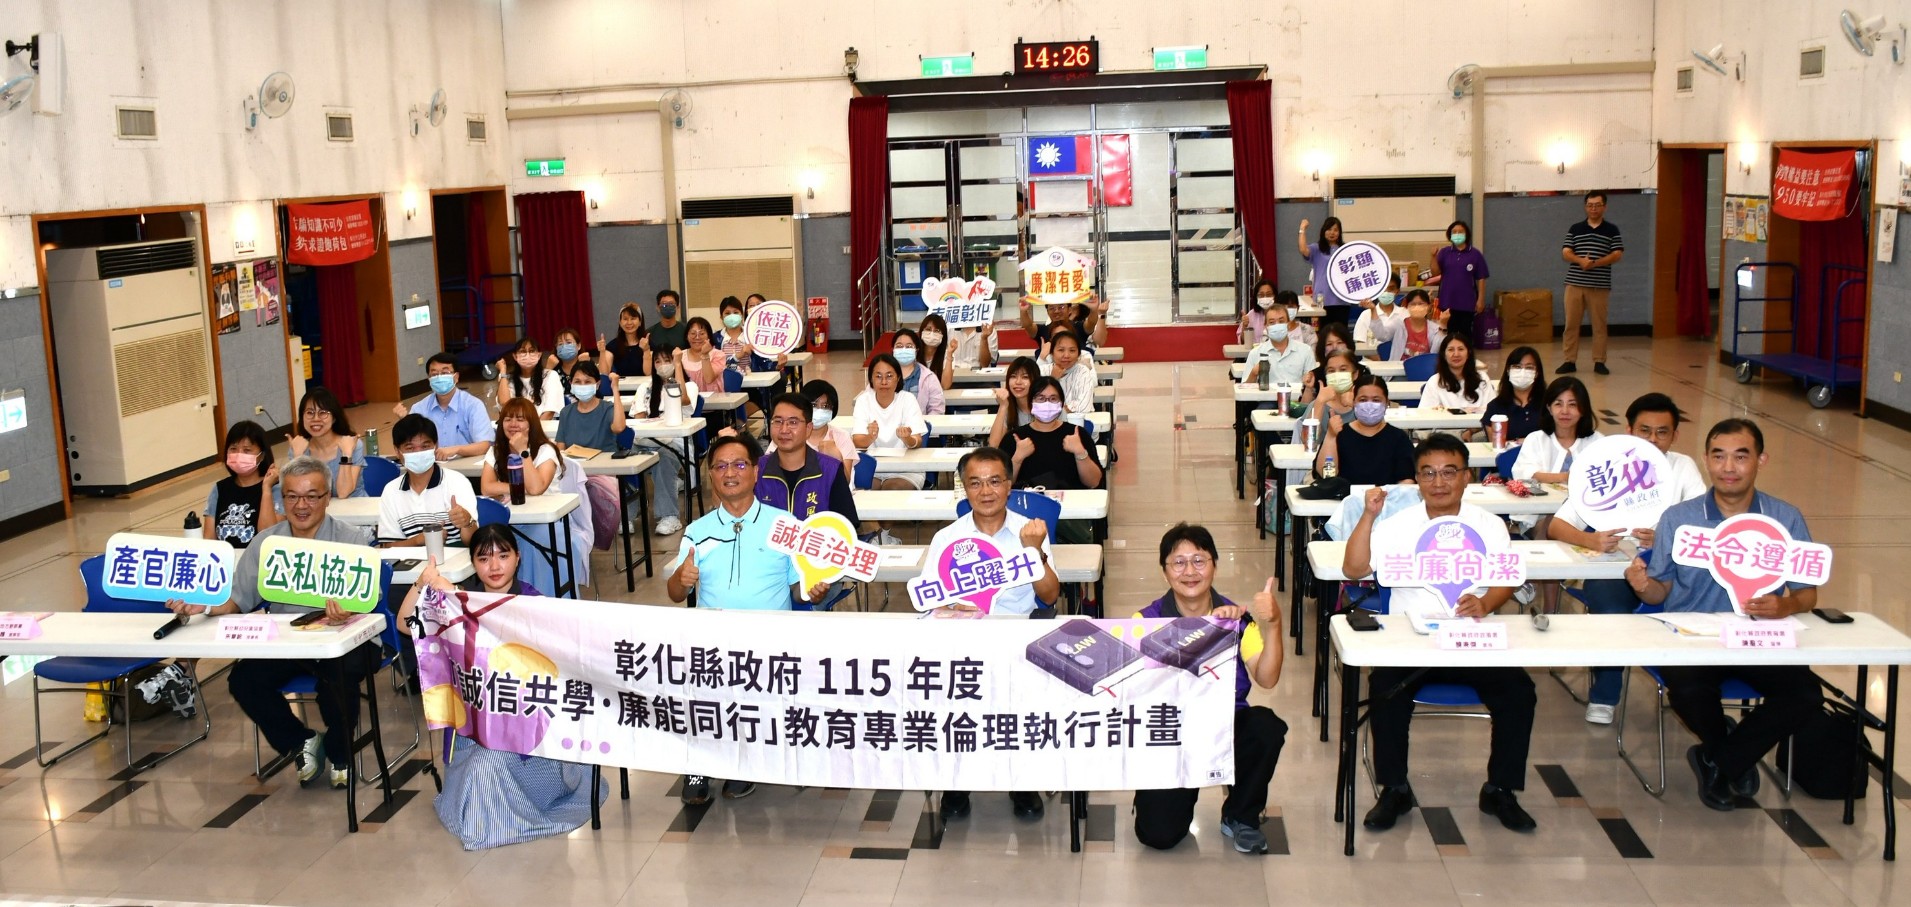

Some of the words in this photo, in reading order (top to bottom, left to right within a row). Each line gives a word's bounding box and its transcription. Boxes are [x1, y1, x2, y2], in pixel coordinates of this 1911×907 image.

[1023, 46, 1090, 68] 14:26
[1338, 250, 1374, 274] 彰顯
[1031, 270, 1084, 294] 廉潔有愛
[1345, 270, 1381, 294] 廉能
[758, 310, 791, 330] 依法
[755, 329, 788, 348] 行政
[1585, 459, 1656, 497] 彰化
[771, 519, 878, 576] 誠信治理
[1678, 530, 1826, 578] 法令遵循
[109, 545, 227, 593] 產官廉心
[266, 549, 373, 599] 公私協力
[914, 553, 1036, 606] 向上躍升
[1384, 552, 1520, 581] 崇廉尚潔
[1066, 635, 1097, 656] LAW
[1177, 629, 1206, 647] LAW
[613, 639, 802, 697] 彰化縣政府
[818, 656, 892, 697] 115
[906, 656, 985, 700] 年度
